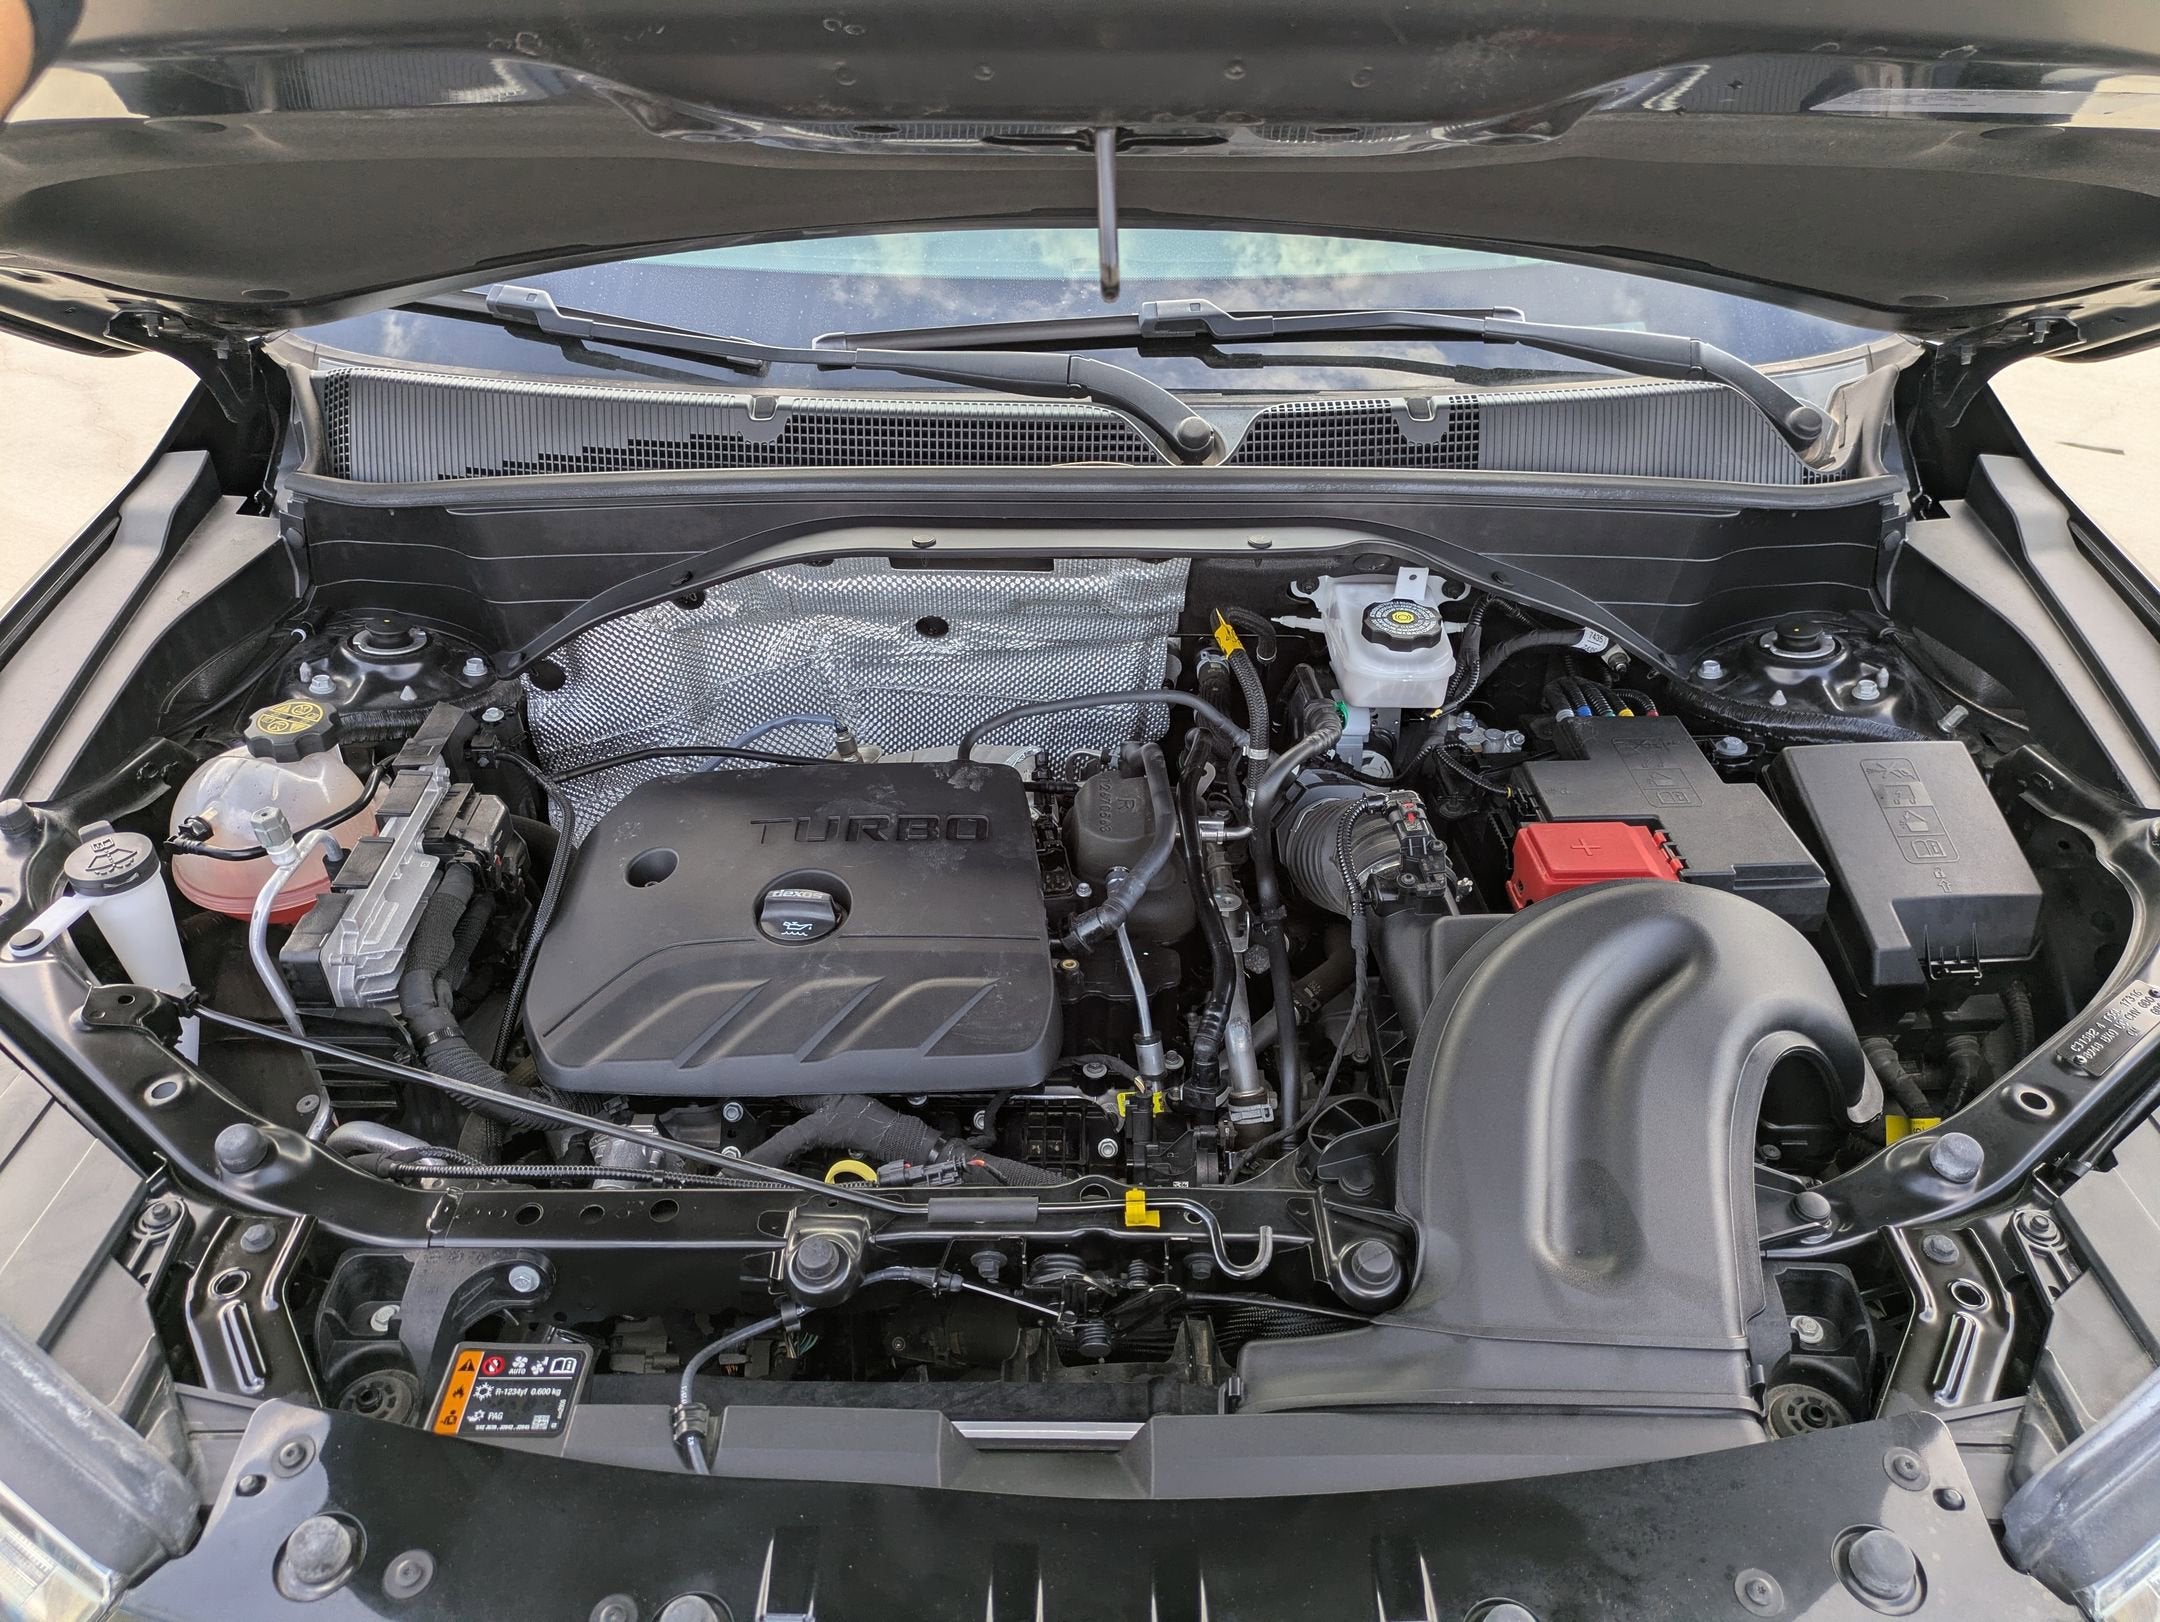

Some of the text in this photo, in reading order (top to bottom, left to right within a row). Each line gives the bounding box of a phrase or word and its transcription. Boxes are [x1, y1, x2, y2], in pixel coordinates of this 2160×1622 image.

[1116, 797, 1137, 812] R
[750, 814, 990, 843] TURBO
[772, 889, 823, 899] dexos
[495, 1388, 562, 1397] R-1234yf 0.600 kg
[488, 1412, 503, 1420] PAG
